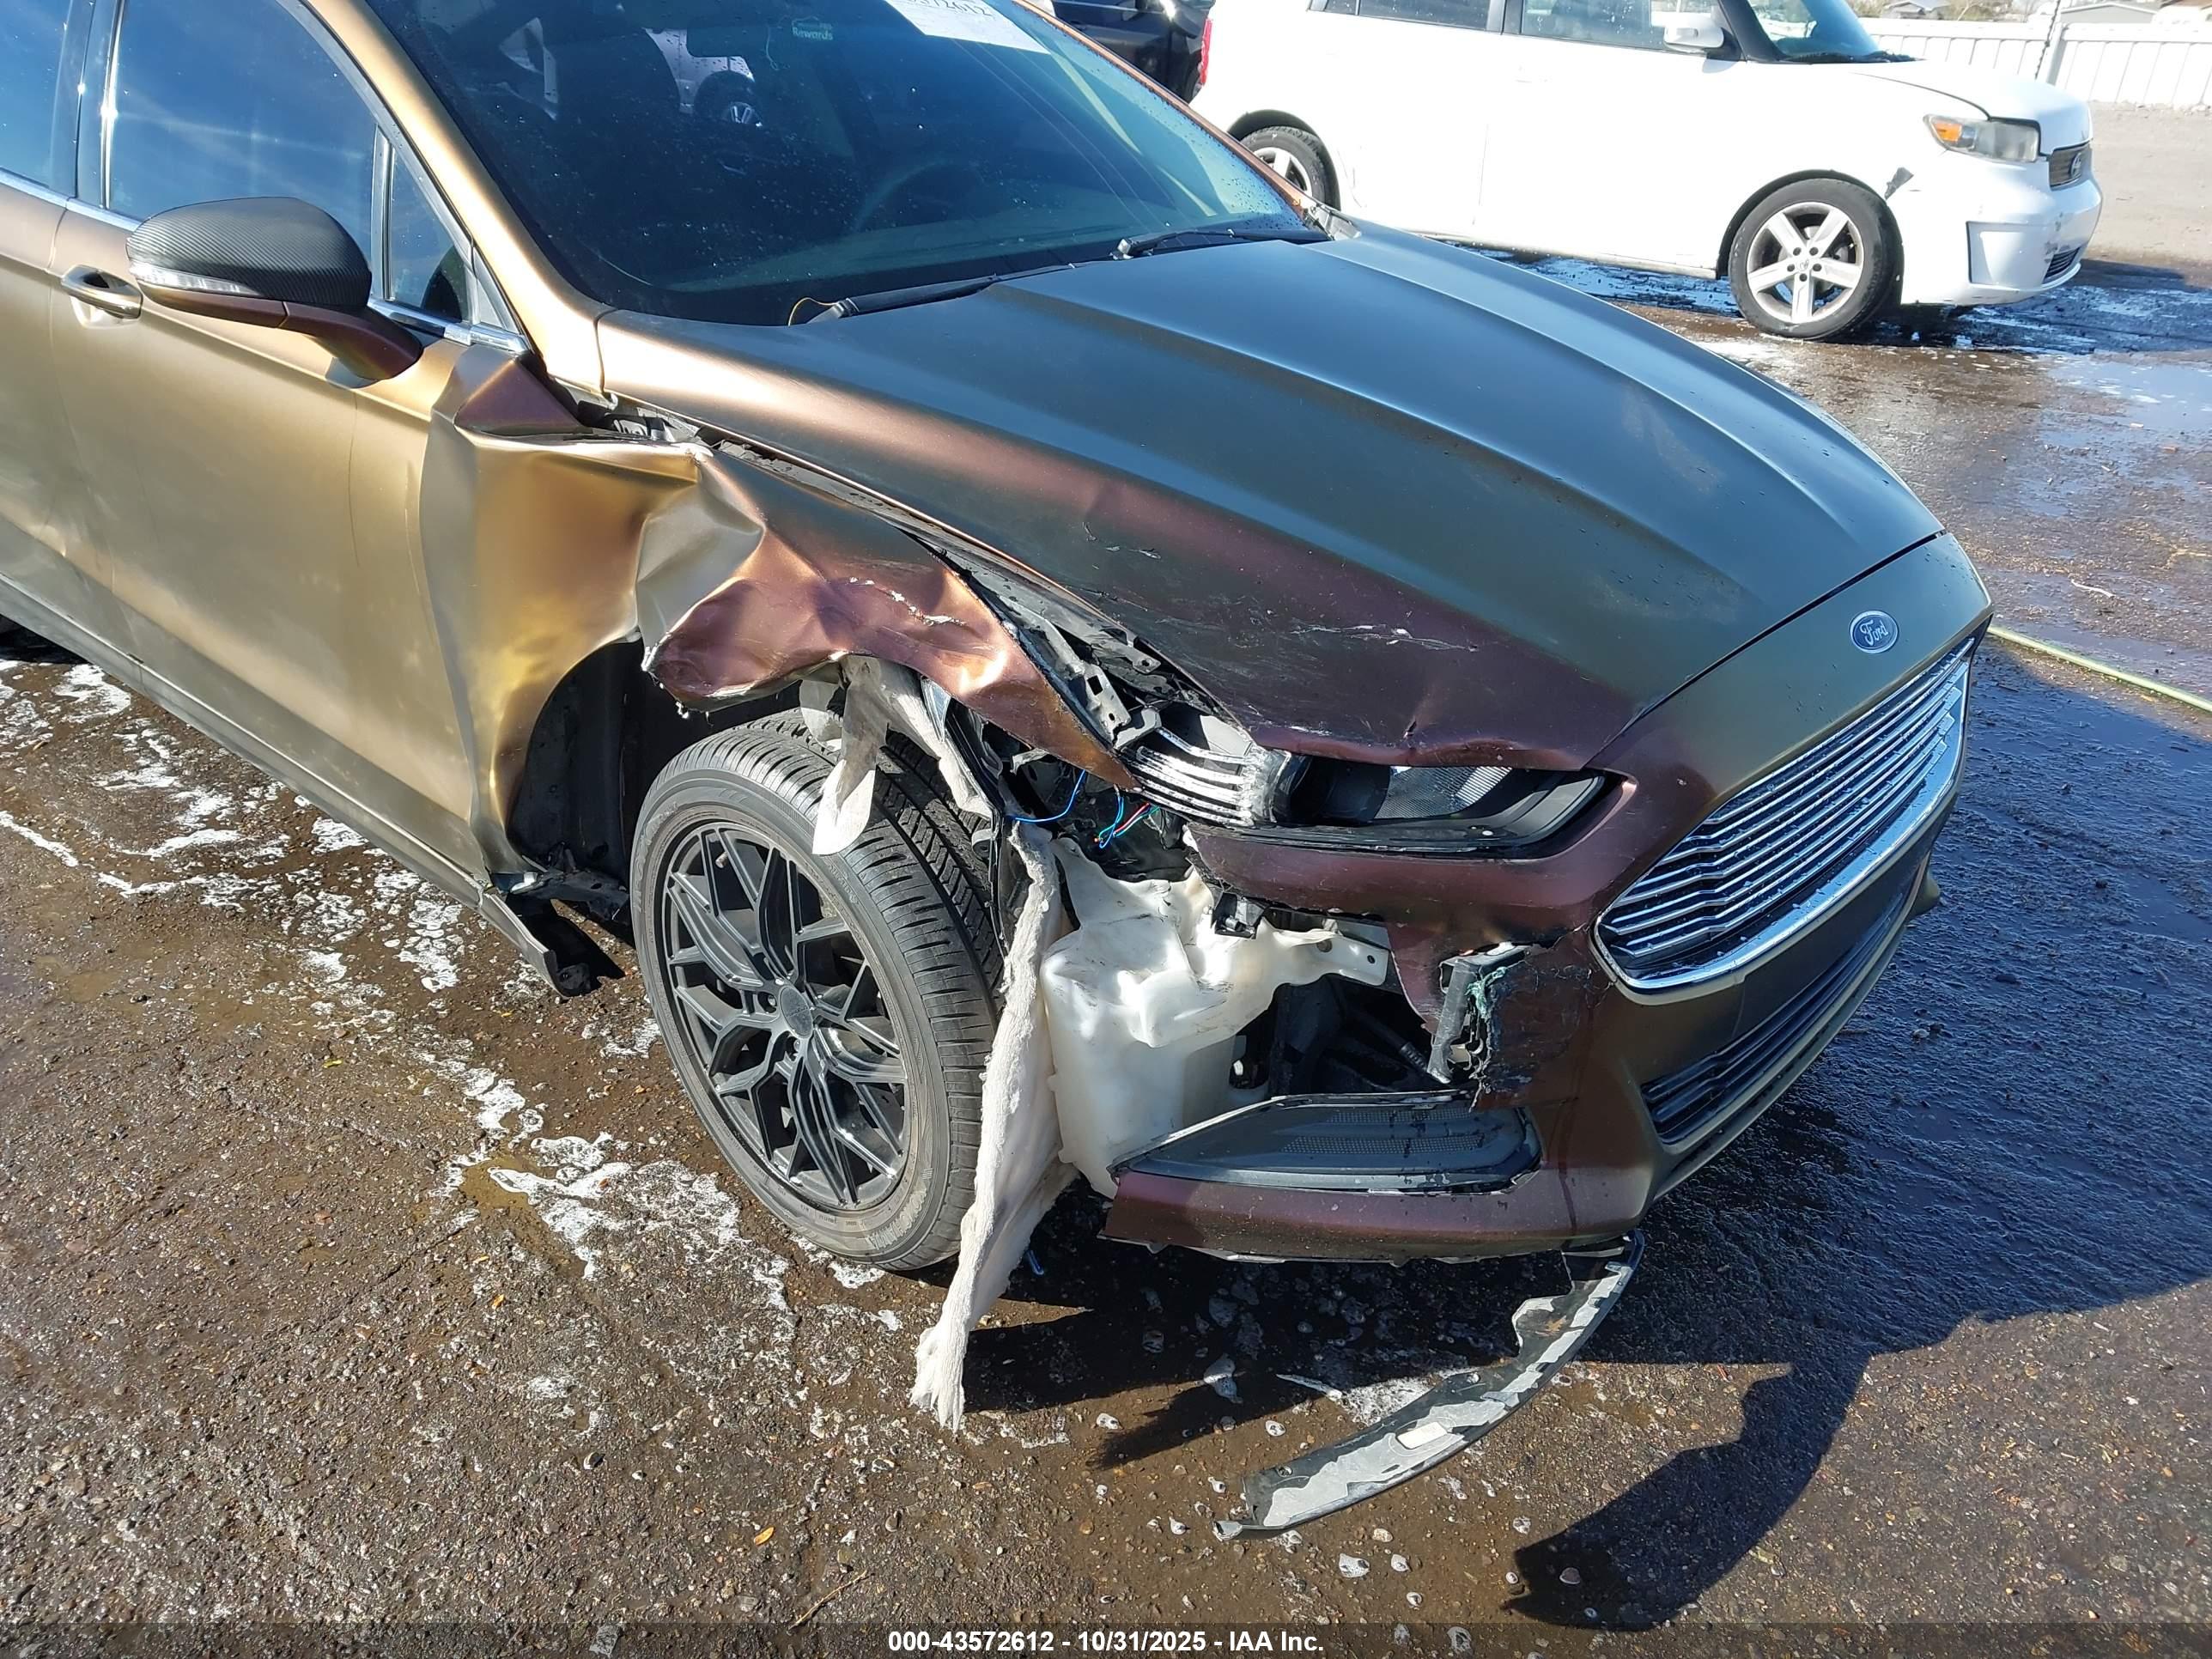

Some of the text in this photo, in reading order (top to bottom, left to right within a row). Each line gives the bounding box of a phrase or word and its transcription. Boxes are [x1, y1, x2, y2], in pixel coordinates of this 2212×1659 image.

[792, 27, 834, 41] Rewards
[1859, 619, 1889, 647] Ford
[866, 1187, 927, 1251] YOKOHAMA
